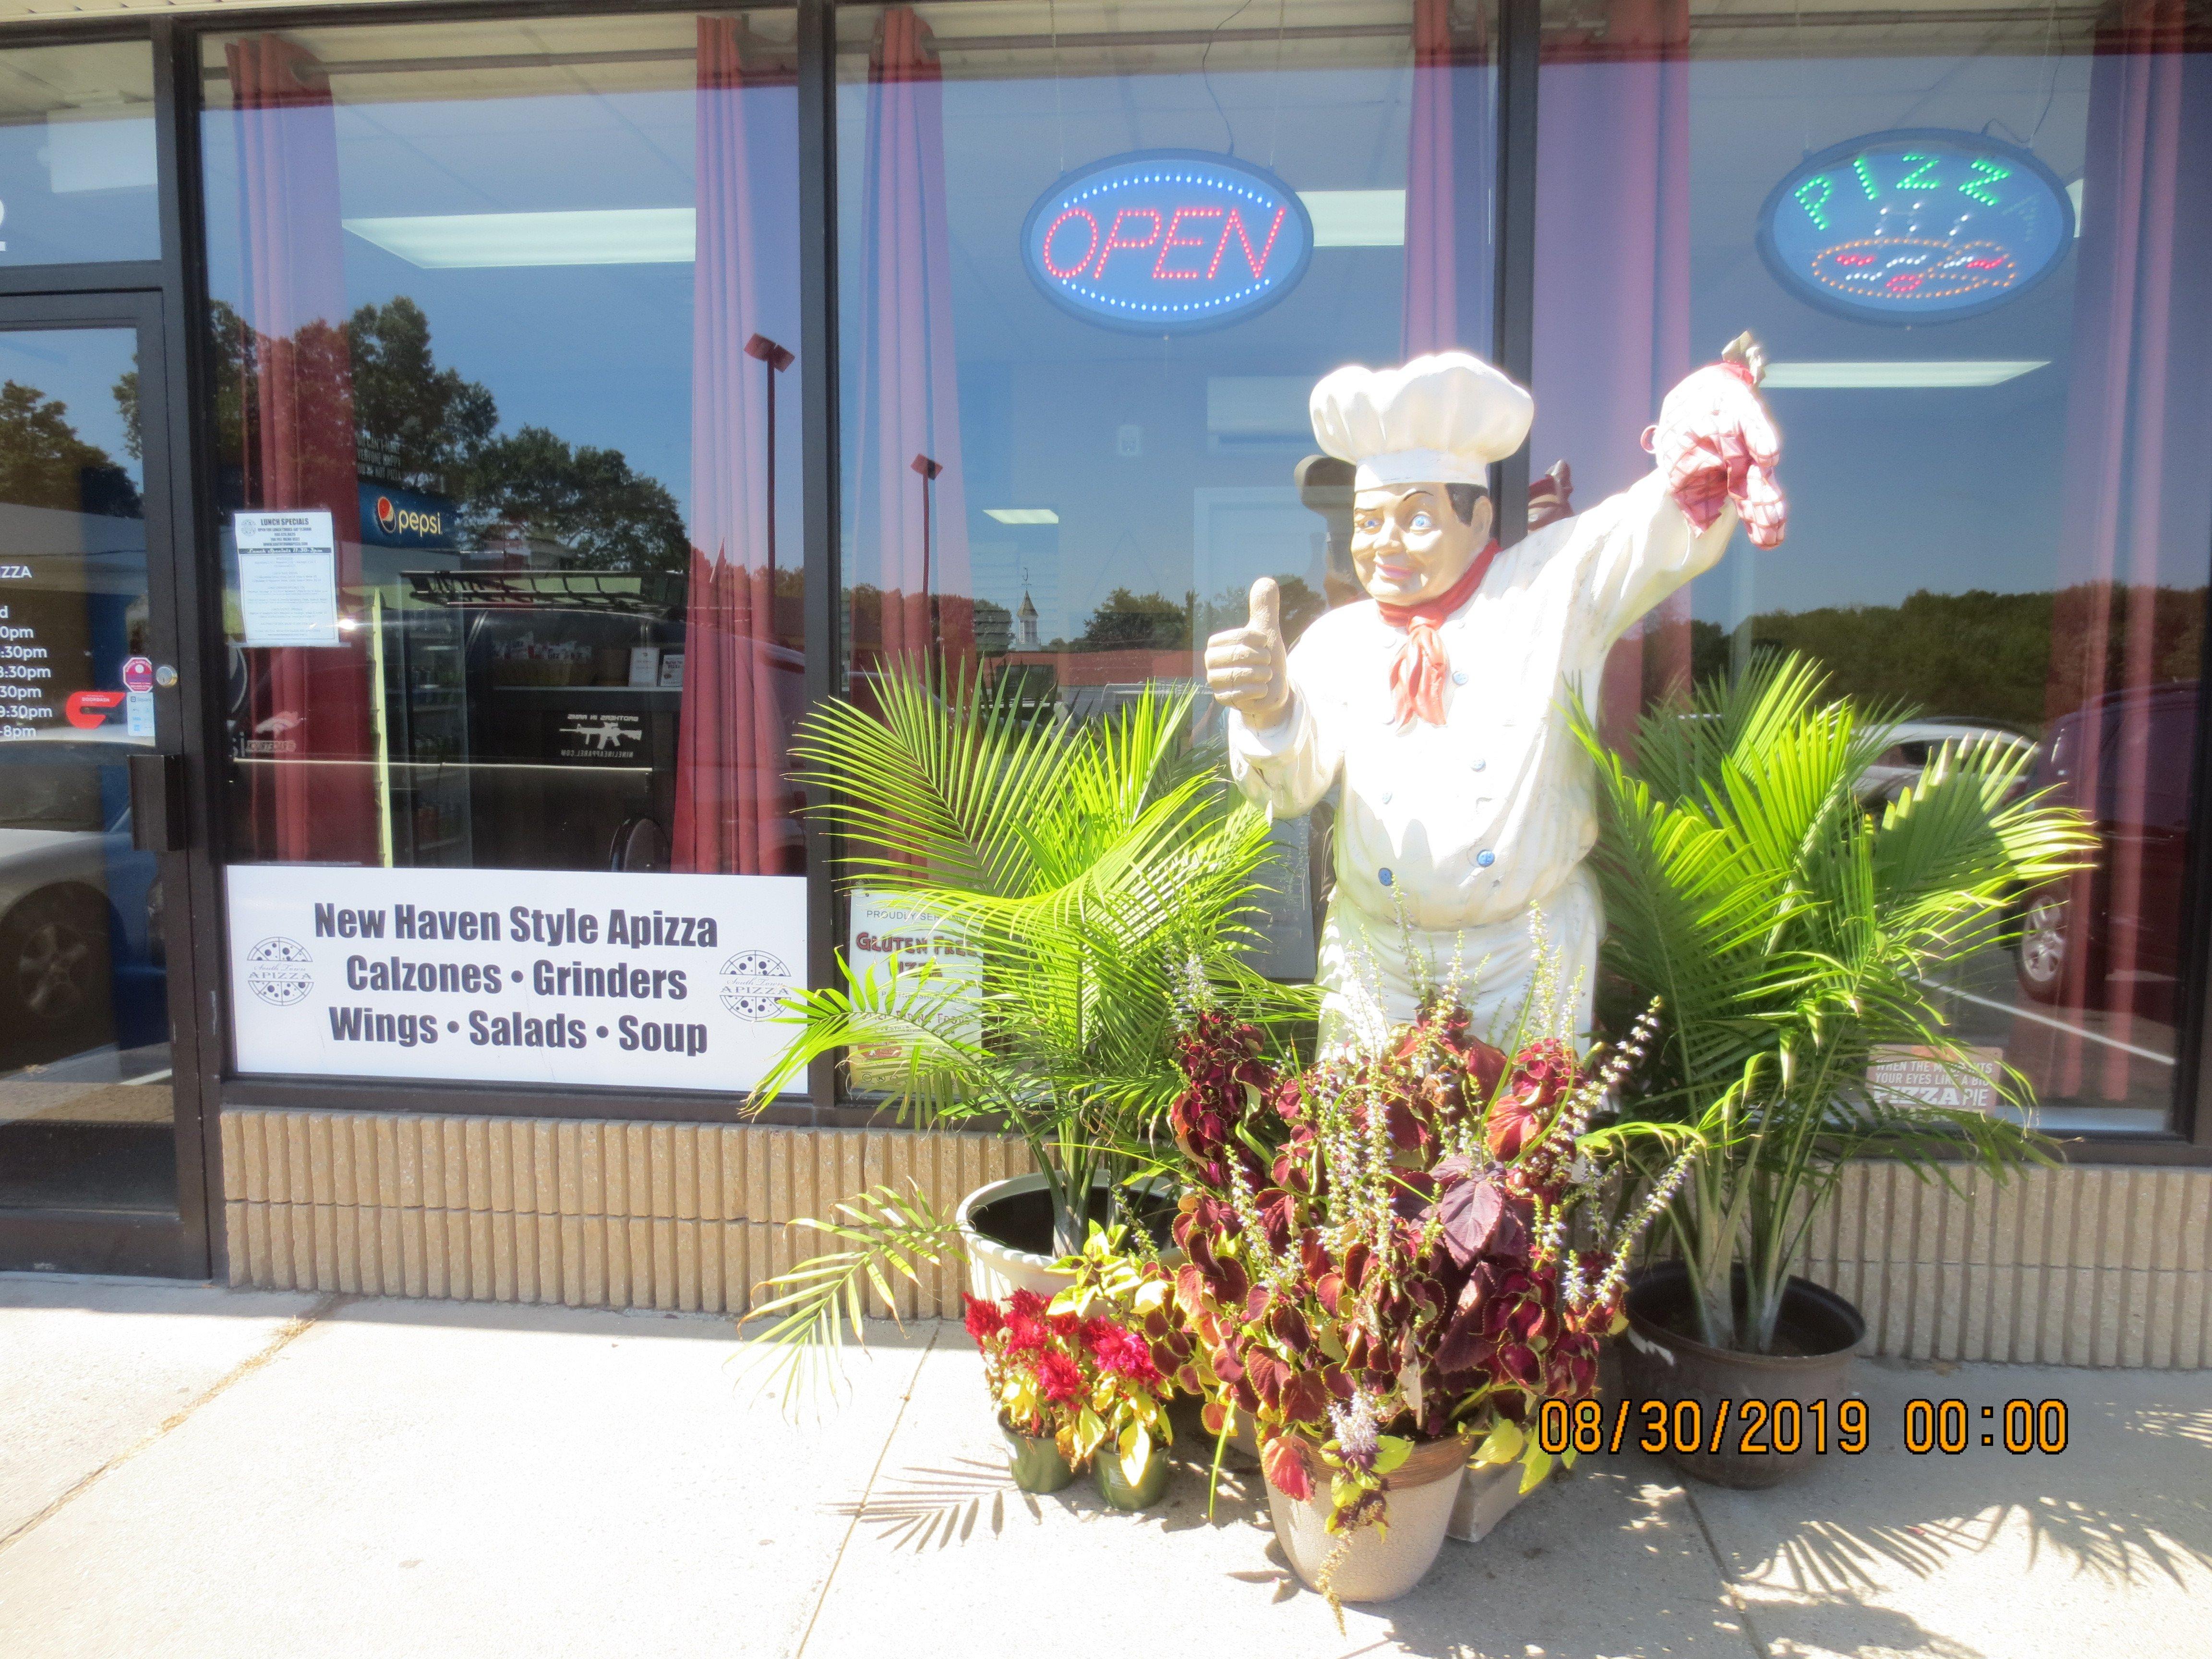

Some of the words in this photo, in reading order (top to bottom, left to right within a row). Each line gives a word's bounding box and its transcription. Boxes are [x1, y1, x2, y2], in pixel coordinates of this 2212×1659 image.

[1043, 207, 1286, 279] OPEN
[399, 510, 440, 537] pepsi
[315, 903, 384, 938] New
[395, 904, 500, 941] Haven
[510, 907, 598, 946] Style
[607, 909, 718, 949] Apizza
[856, 932, 927, 954] GLUTEN
[347, 955, 502, 993] Calzones
[533, 960, 687, 999] Grinders
[720, 986, 789, 995] APIZZA
[329, 1007, 437, 1047] Wings
[469, 1010, 587, 1049] Salads
[618, 1016, 707, 1056] Soup
[1911, 1060, 1931, 1072] THE
[1875, 1073, 1903, 1084] YOUR
[1906, 1073, 1932, 1084] EYES
[1935, 1074, 1960, 1085] LIK
[1873, 1085, 1961, 1106] PIZZA
[1962, 1087, 1990, 1106] PIE
